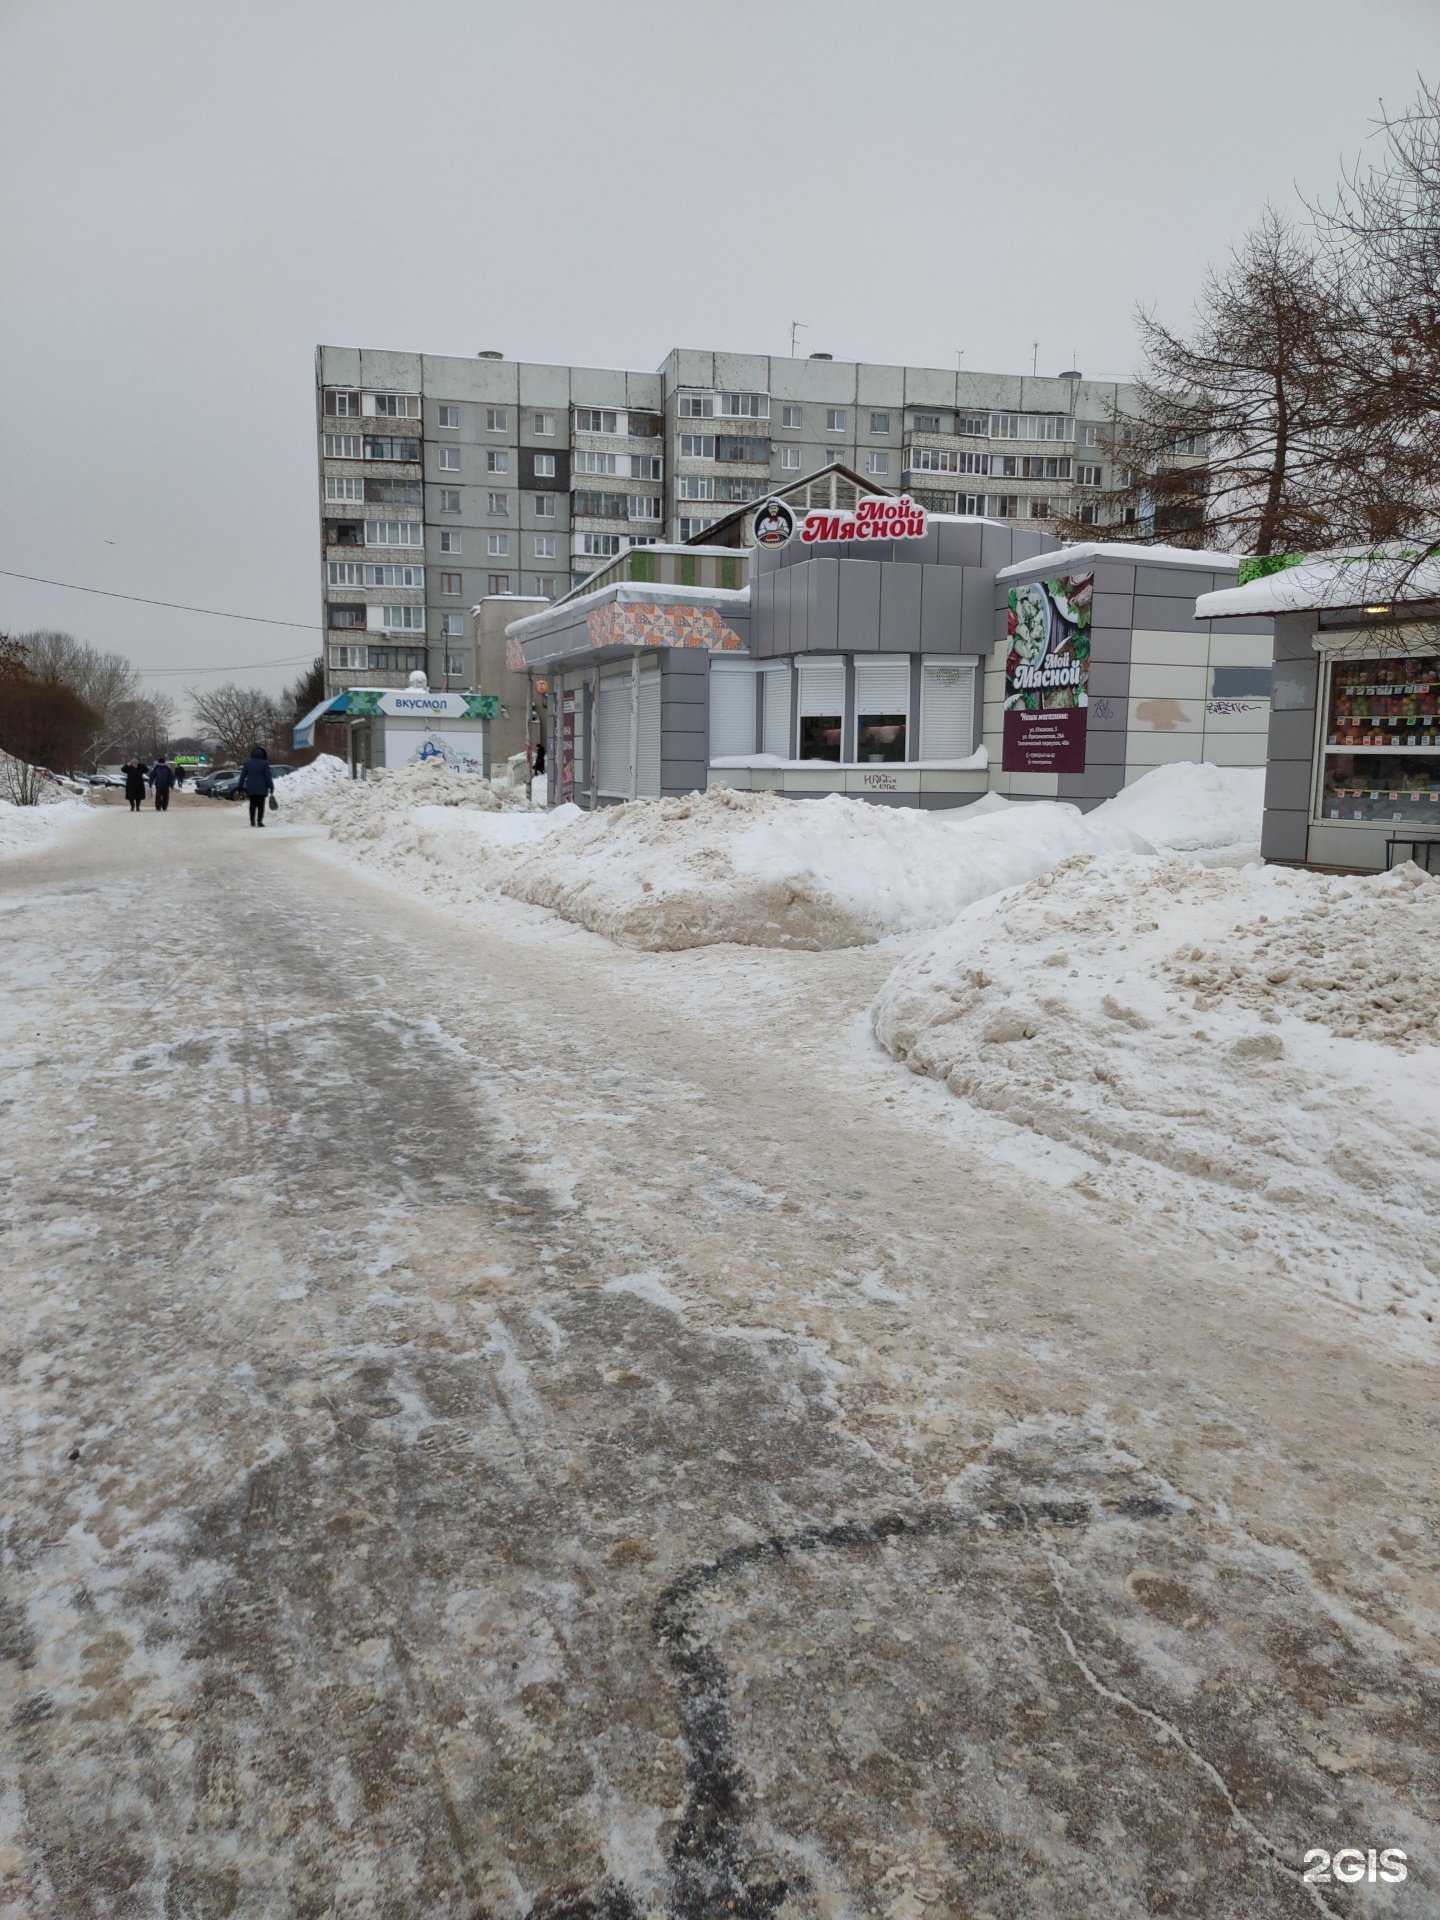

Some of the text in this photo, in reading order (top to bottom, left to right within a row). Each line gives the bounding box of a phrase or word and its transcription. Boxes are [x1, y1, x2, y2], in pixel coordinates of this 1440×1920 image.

[856, 499, 911, 521] Мой
[802, 509, 924, 542] Мясной
[1044, 652, 1070, 670] Мой
[1013, 660, 1080, 689] Мясной
